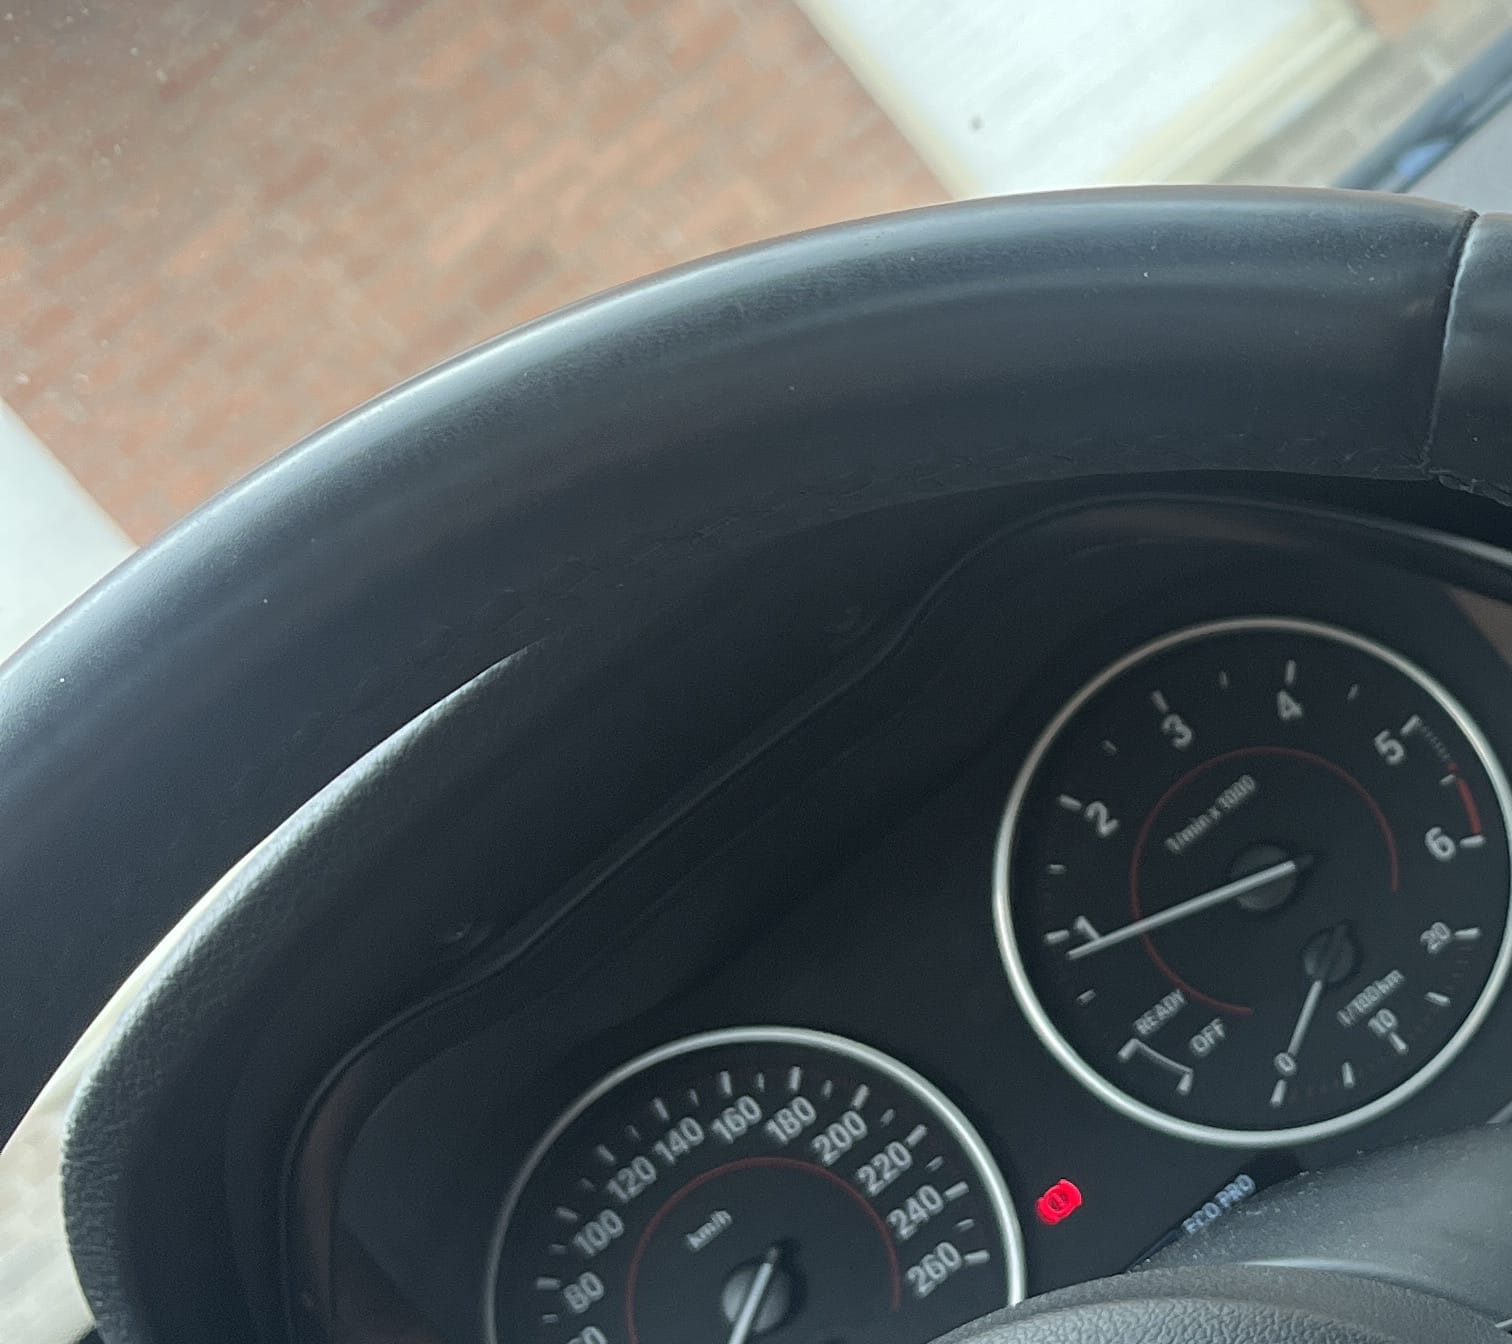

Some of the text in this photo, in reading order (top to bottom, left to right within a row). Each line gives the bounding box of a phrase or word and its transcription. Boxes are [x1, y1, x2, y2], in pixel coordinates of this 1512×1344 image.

[1275, 689, 1303, 721] 4
[1160, 712, 1195, 750] 3
[1373, 729, 1405, 765] 5
[1084, 800, 1119, 837] 2
[1423, 826, 1457, 861] 6
[1132, 989, 1188, 1038] READY
[1367, 1008, 1398, 1035] 10
[1189, 1019, 1227, 1056] OFF
[1273, 1052, 1297, 1078] 0
[652, 1116, 704, 1166] 140
[710, 1094, 763, 1146] 160
[765, 1095, 818, 1147] 180
[811, 1109, 868, 1166] 200
[606, 1154, 657, 1205] 120
[855, 1140, 912, 1196] 220
[572, 1208, 625, 1259] 100
[685, 1208, 734, 1253] km/h
[886, 1182, 944, 1240] 240
[562, 1270, 605, 1314] 80
[905, 1240, 962, 1298] 260
